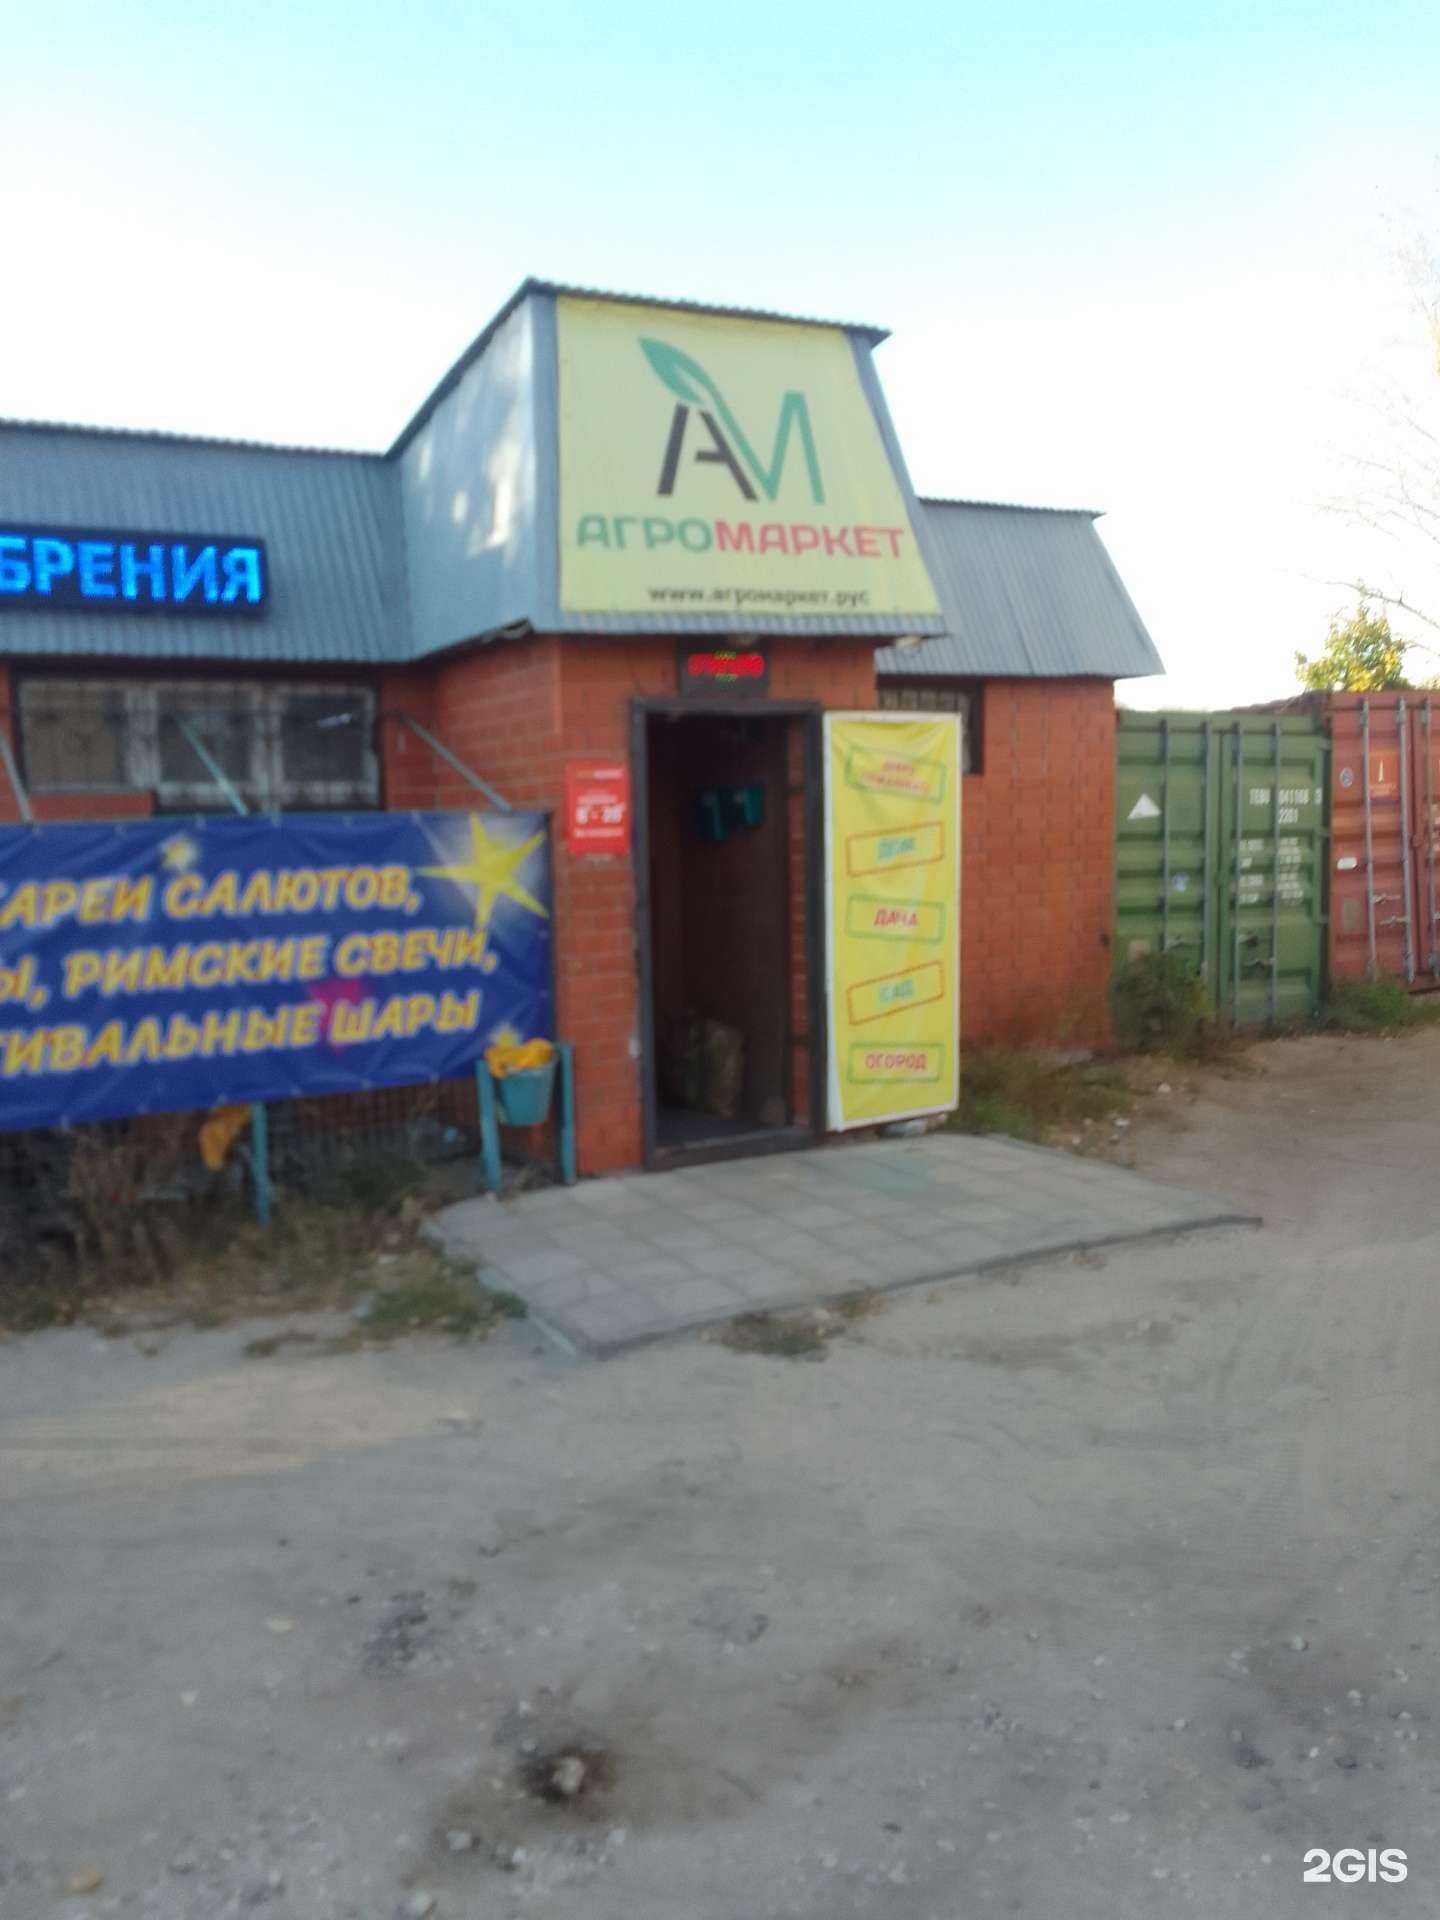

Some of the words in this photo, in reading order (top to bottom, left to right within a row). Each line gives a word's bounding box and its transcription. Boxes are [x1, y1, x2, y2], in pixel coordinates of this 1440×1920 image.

[576, 515, 905, 559] АГРОМАРКЕТ
[0, 532, 262, 603] БРЕНИЯ
[164, 864, 422, 918] САЛЮТОВ,
[64, 935, 328, 998] РИМСКИЕ
[334, 927, 497, 976] СВЕЧИ,
[329, 989, 481, 1045] ШАРЫ
[864, 1053, 927, 1070] ОГОРОД
